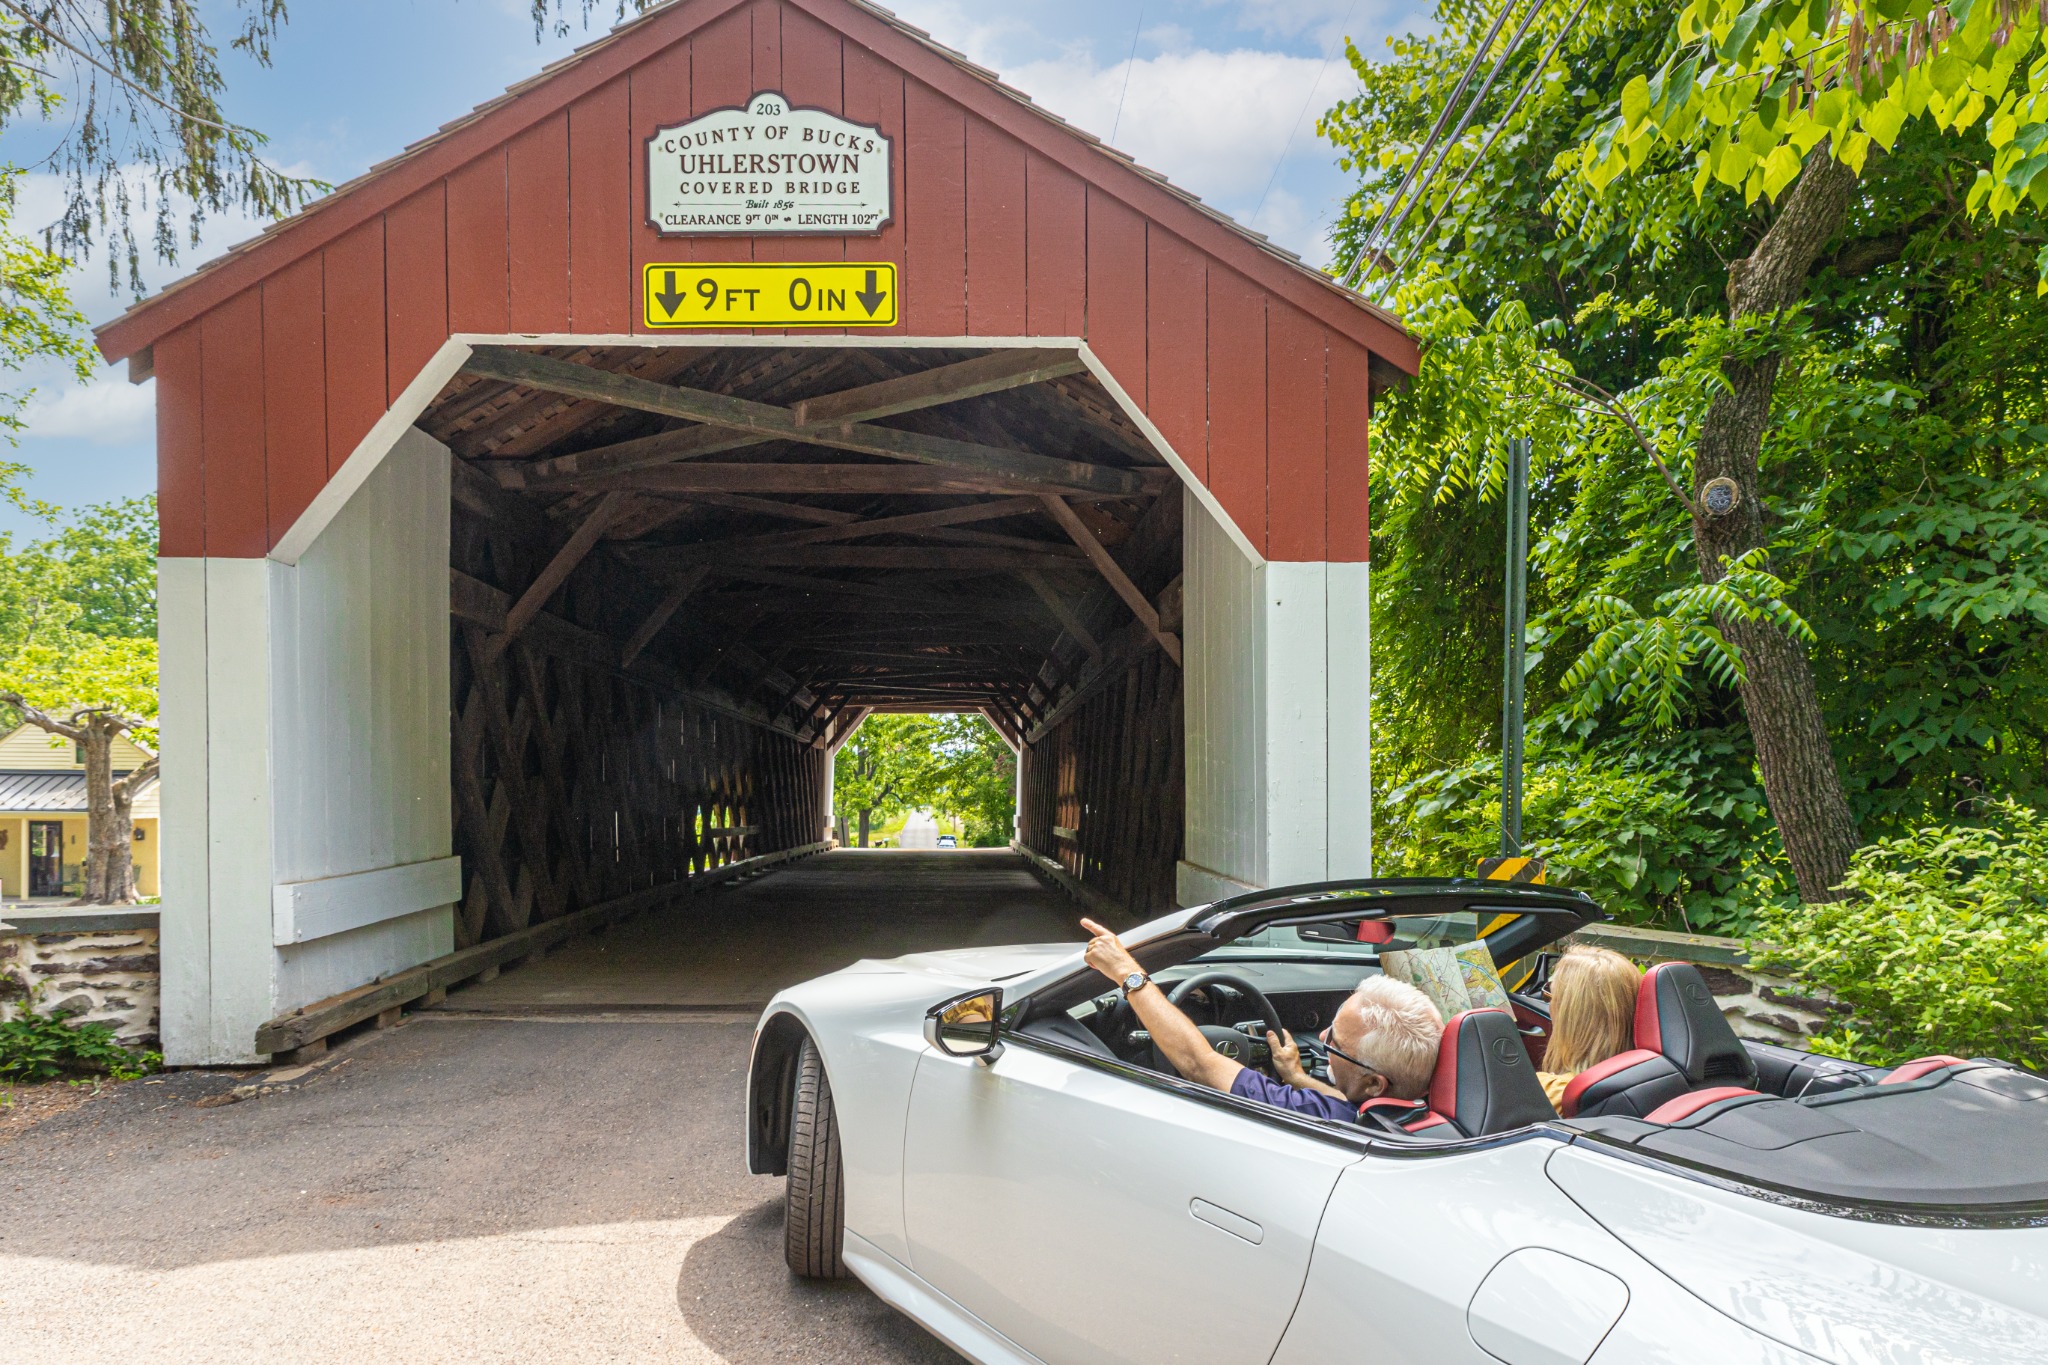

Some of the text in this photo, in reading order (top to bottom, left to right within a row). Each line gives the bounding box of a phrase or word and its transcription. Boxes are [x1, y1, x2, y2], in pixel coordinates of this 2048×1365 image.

[756, 103, 781, 116] 203
[664, 125, 875, 154] COUNTY OF BUCKS
[679, 153, 860, 174] UHLERSTOWN
[680, 181, 861, 194] COVERED BRIDGE
[745, 199, 795, 210] Built 1856
[665, 214, 742, 225] CLEARANCE
[798, 214, 848, 225] LENGTH
